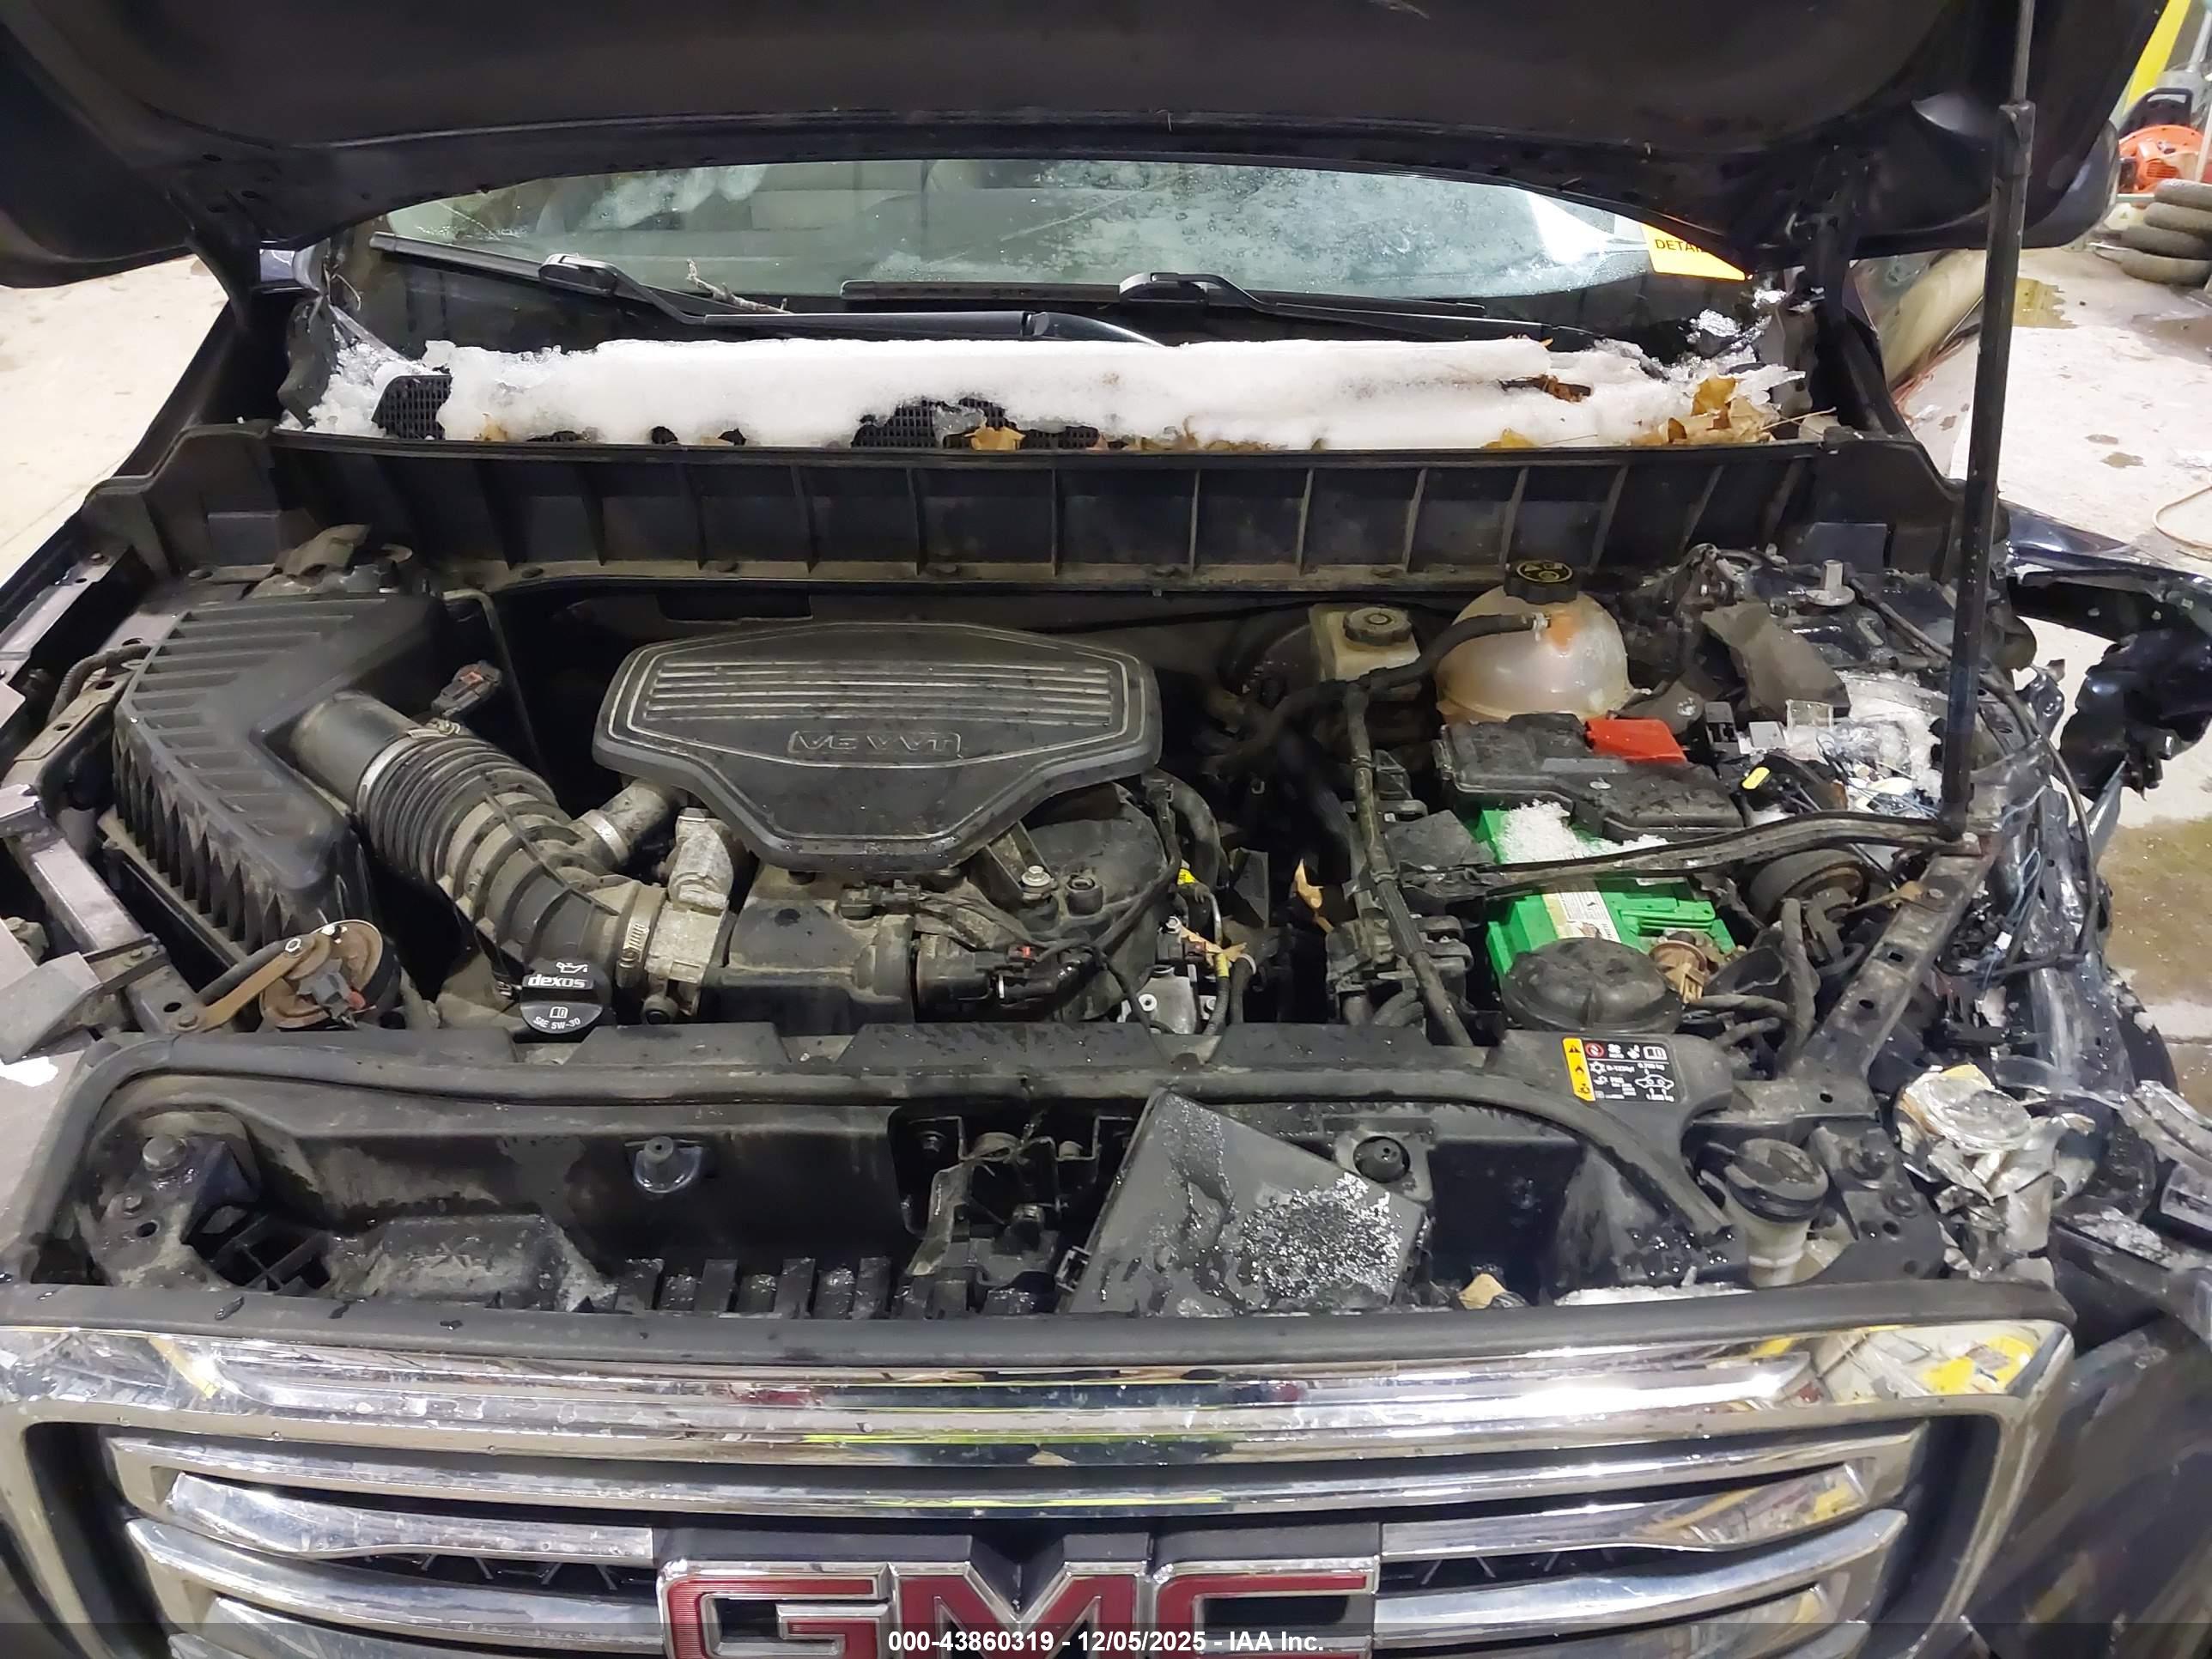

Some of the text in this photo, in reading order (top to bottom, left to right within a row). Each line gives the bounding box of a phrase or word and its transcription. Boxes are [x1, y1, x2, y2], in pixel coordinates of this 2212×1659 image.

[527, 974, 588, 988] dexos
[532, 1016, 581, 1030] SAE 5W-30
[655, 1558, 1376, 1659] GMC
